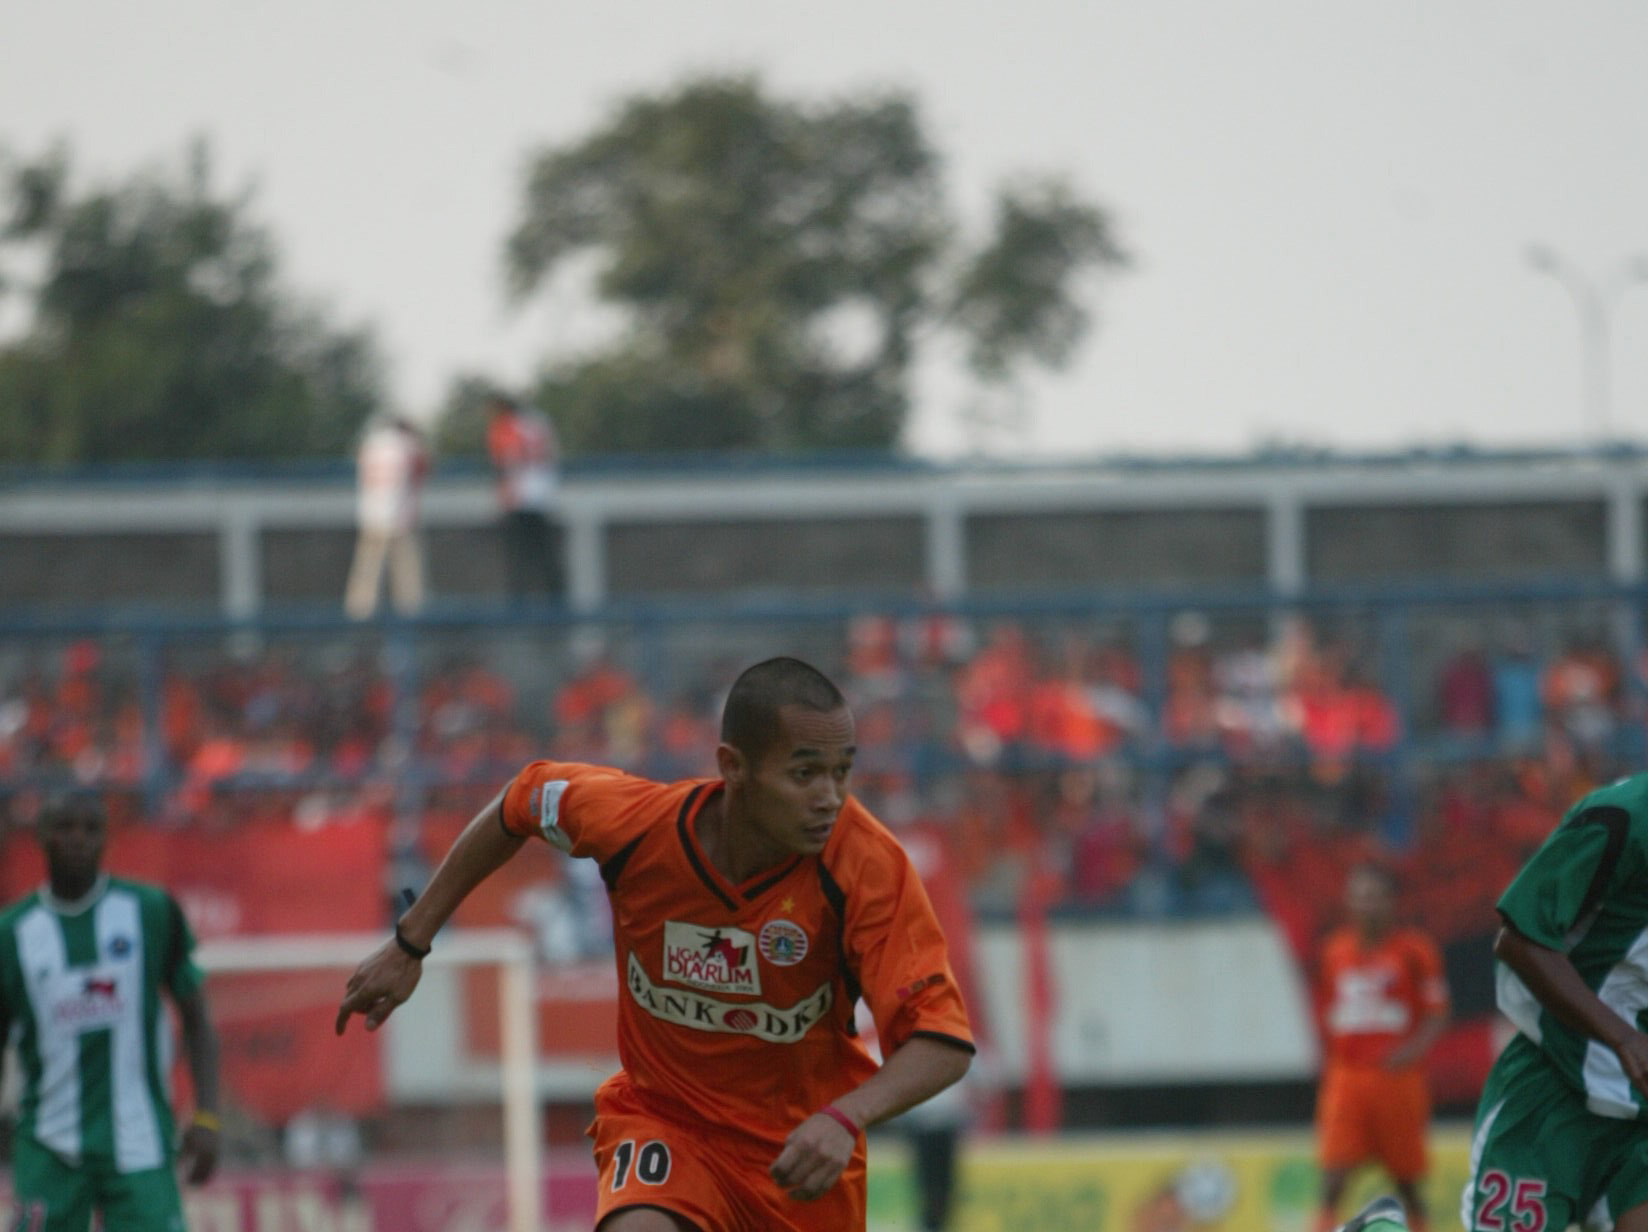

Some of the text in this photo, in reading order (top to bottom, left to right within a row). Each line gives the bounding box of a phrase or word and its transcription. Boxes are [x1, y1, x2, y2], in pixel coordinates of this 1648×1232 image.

[667, 945, 704, 961] LIGA
[668, 958, 753, 984] DJARUM
[630, 966, 827, 1036] BANK DKI
[611, 1139, 671, 1193] 10
